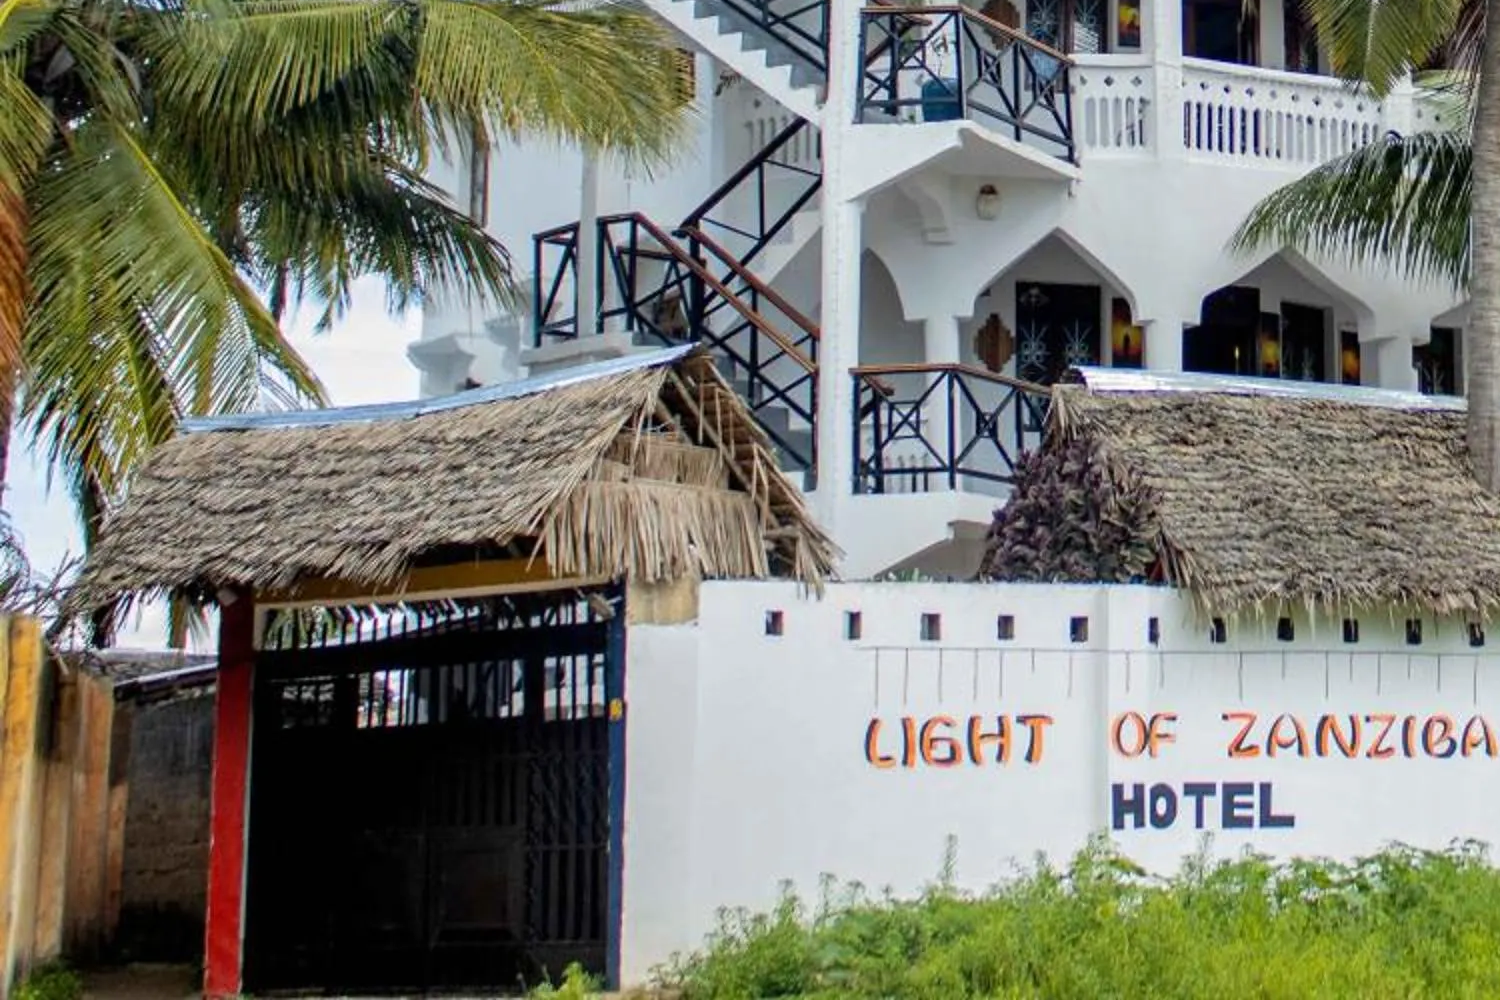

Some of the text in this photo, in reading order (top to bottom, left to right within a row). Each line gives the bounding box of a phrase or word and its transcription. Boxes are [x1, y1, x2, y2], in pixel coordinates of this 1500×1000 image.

[865, 714, 1054, 768] LIGHT
[1111, 712, 1178, 758] OF
[1111, 782, 1295, 830] HOTEL
